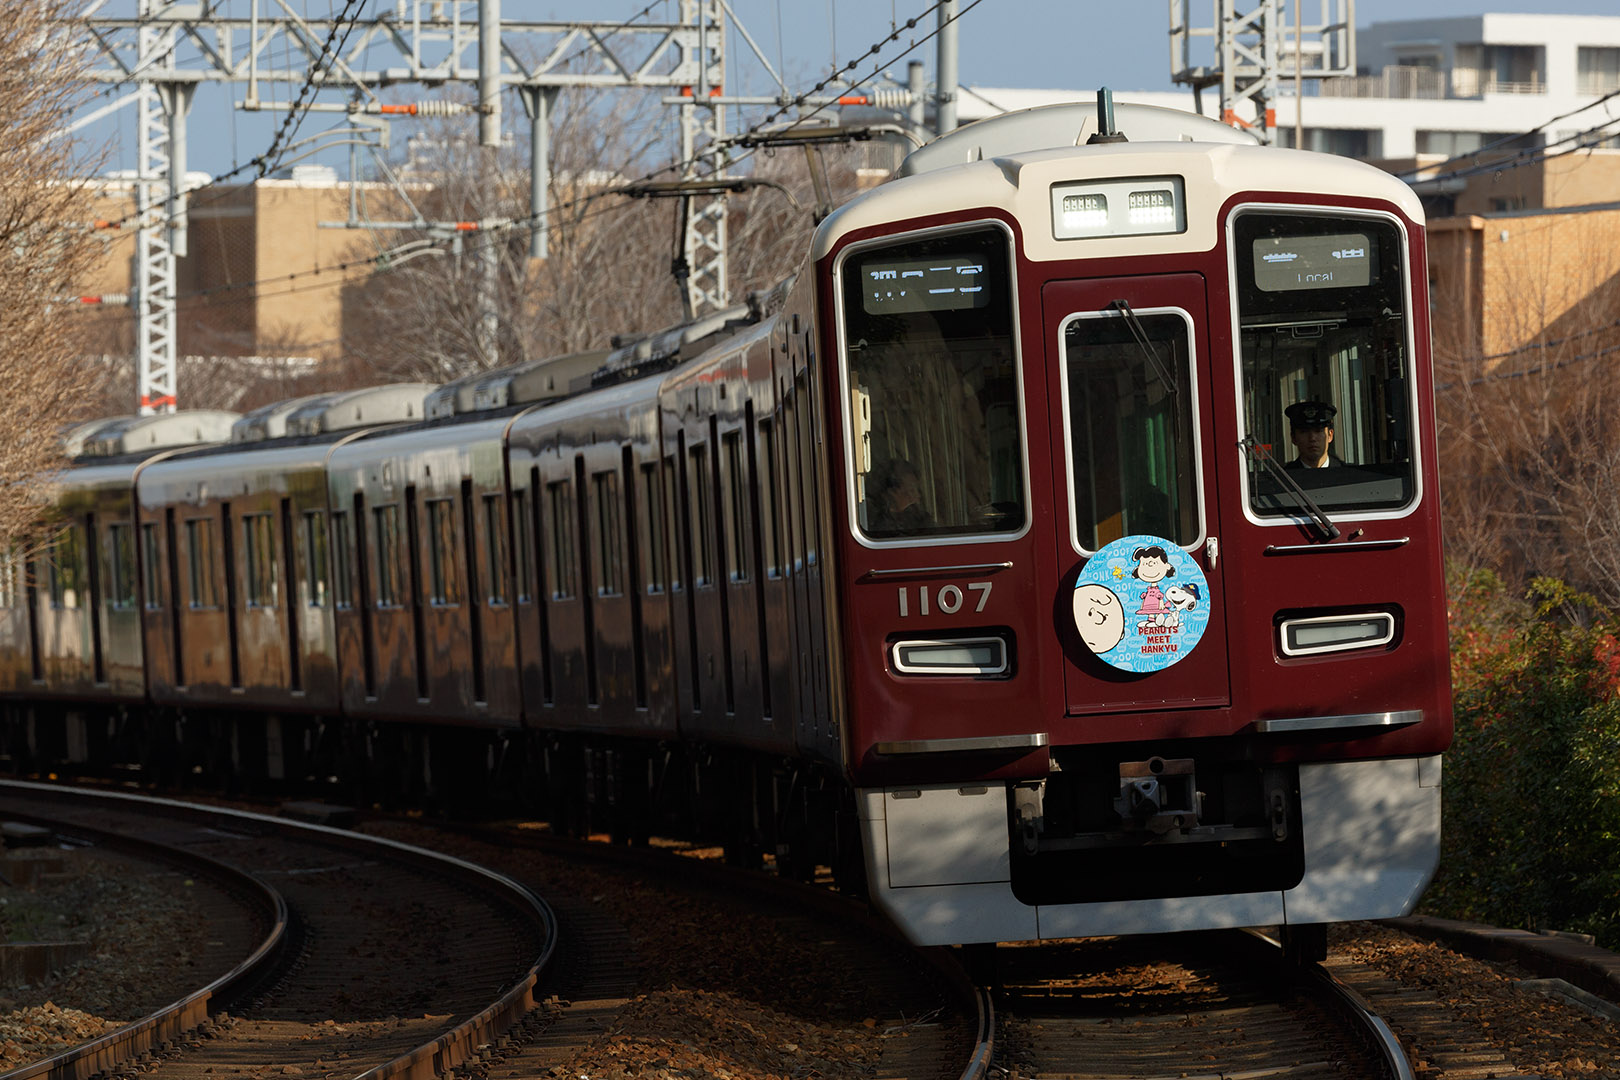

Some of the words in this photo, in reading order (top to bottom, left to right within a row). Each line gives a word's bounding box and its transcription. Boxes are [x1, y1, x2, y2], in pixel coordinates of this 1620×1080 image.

[898, 581, 993, 617] 1107
[1138, 626, 1178, 636] PEANUTS
[1147, 635, 1170, 644] MEET
[1141, 644, 1177, 654] HANKYU
